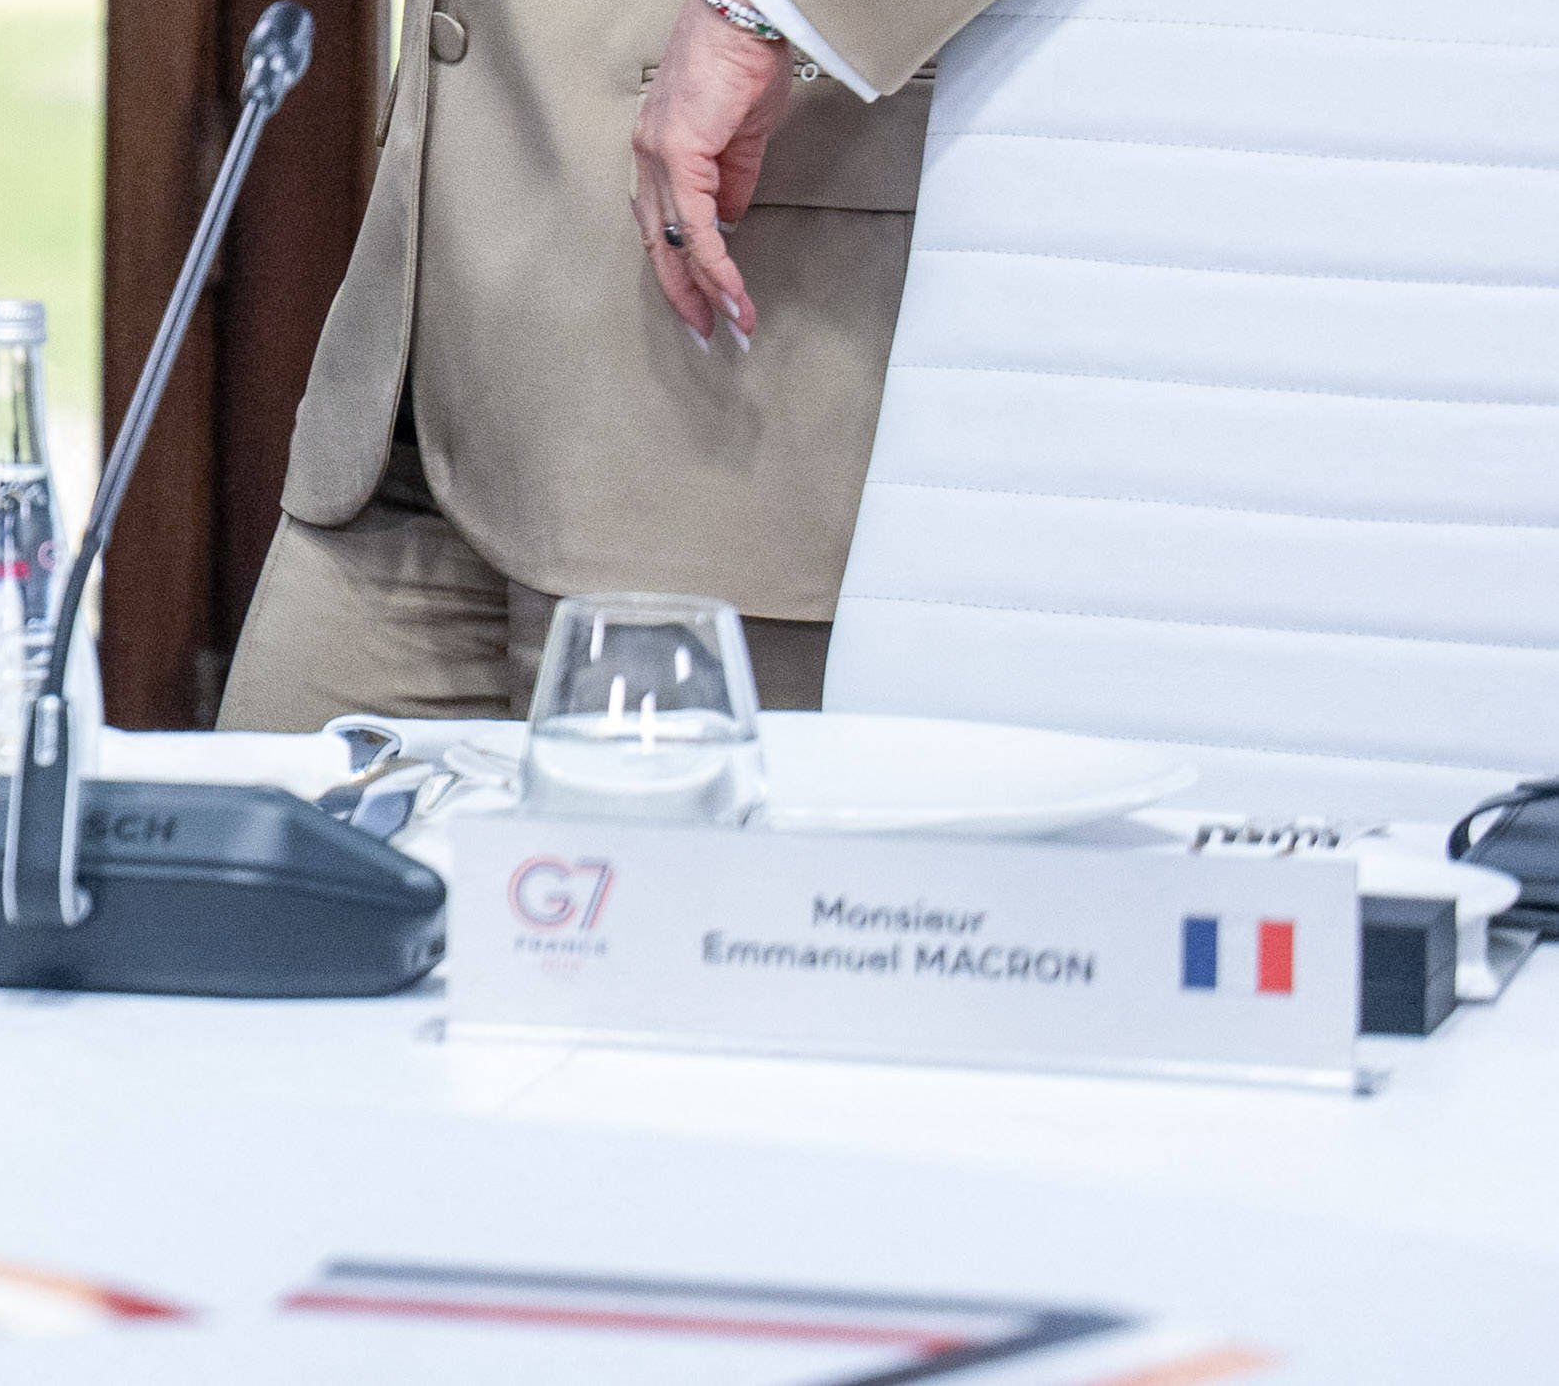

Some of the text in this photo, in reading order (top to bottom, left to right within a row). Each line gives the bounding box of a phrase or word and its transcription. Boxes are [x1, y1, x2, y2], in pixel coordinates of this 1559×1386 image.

[508, 853, 616, 932] G7
[812, 891, 988, 935] Monsieur
[701, 927, 1096, 986] Emmanuel MACRON
